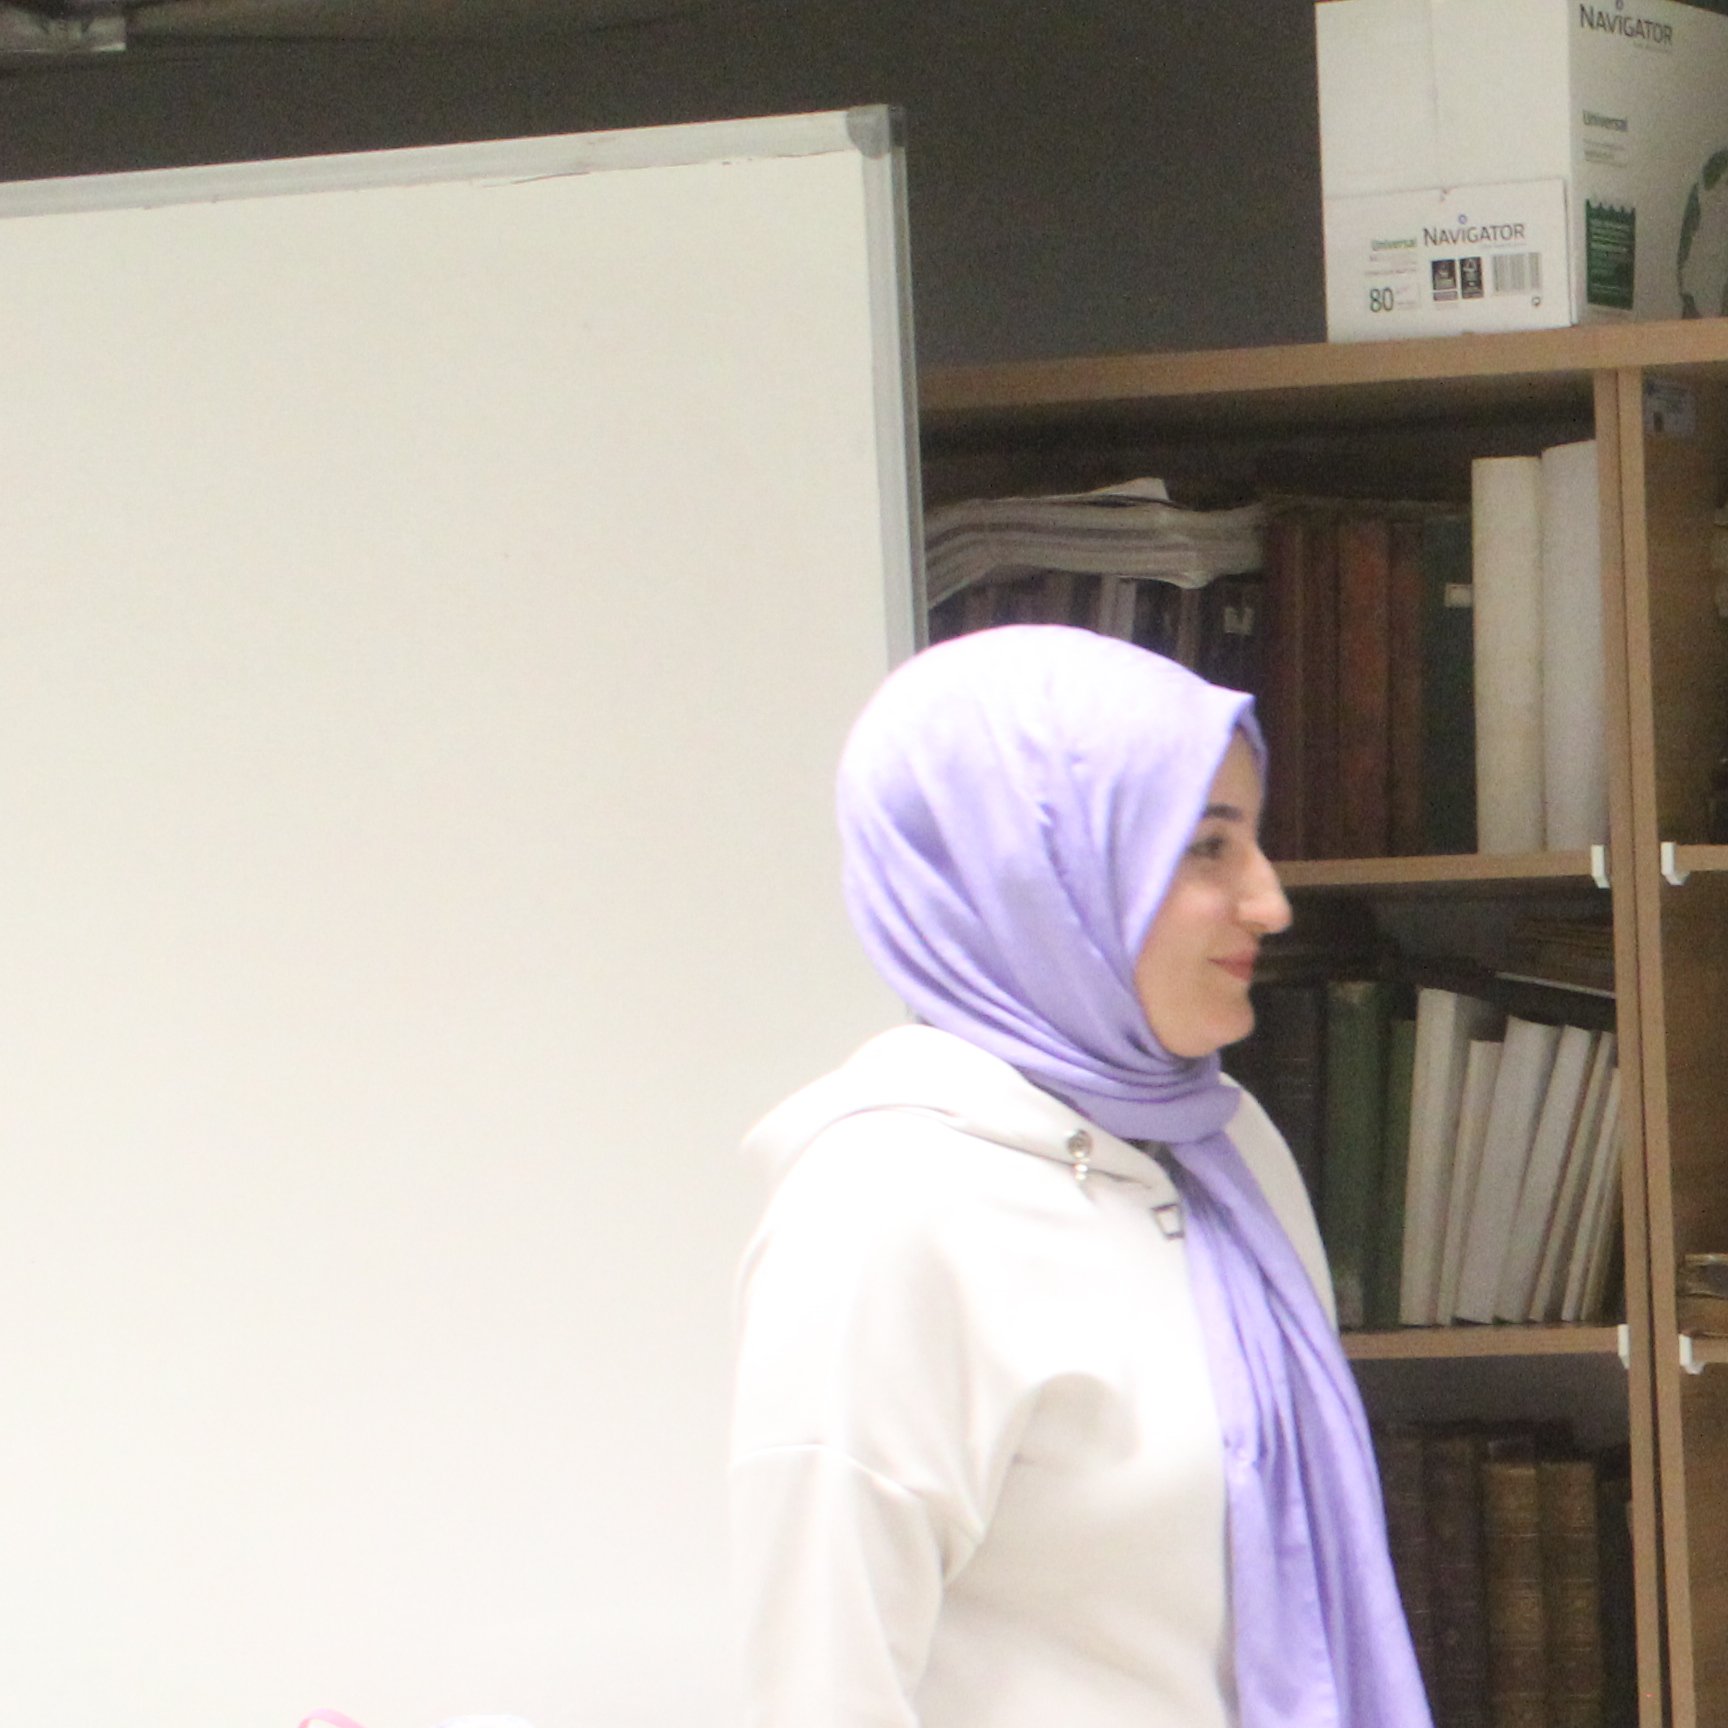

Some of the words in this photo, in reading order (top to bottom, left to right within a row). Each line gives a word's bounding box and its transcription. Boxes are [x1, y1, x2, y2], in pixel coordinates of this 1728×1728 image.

[1579, 3, 1673, 46] NAVIGATOR
[1423, 223, 1526, 247] NAVIGATOR
[1369, 286, 1394, 312] 80
